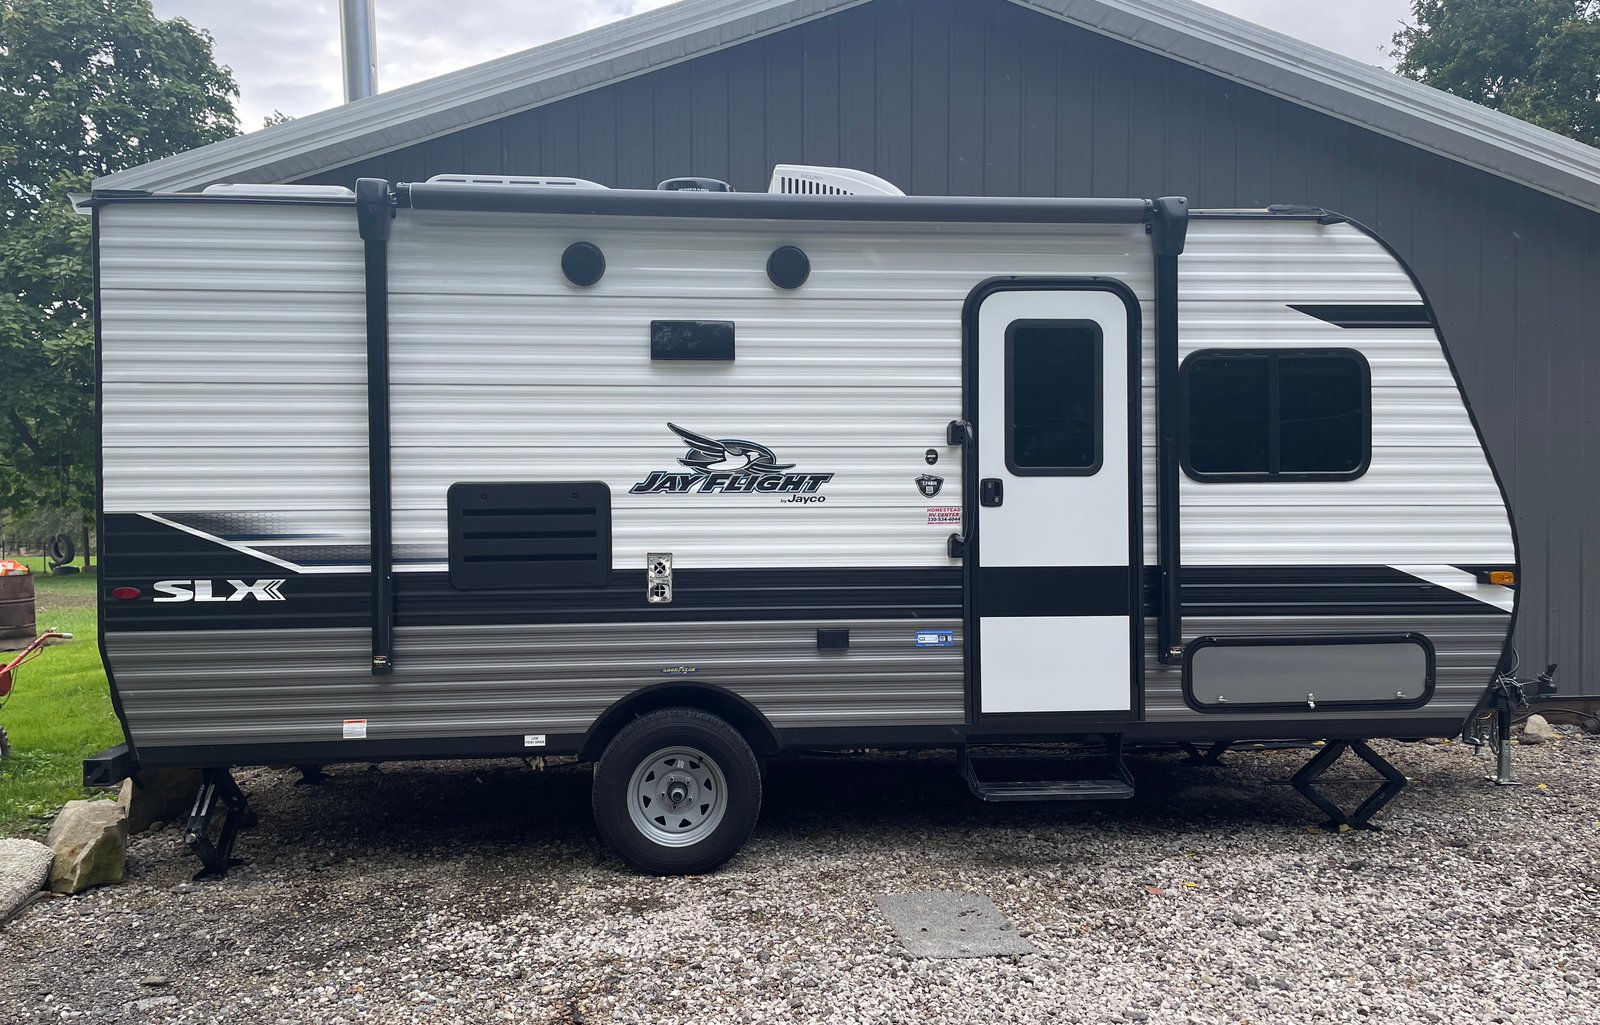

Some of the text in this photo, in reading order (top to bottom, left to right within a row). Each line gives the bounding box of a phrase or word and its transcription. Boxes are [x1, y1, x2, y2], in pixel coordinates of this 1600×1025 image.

[628, 471, 835, 494] JAY FLIGHT
[787, 494, 826, 505] Jayco
[152, 578, 287, 603] SLX
